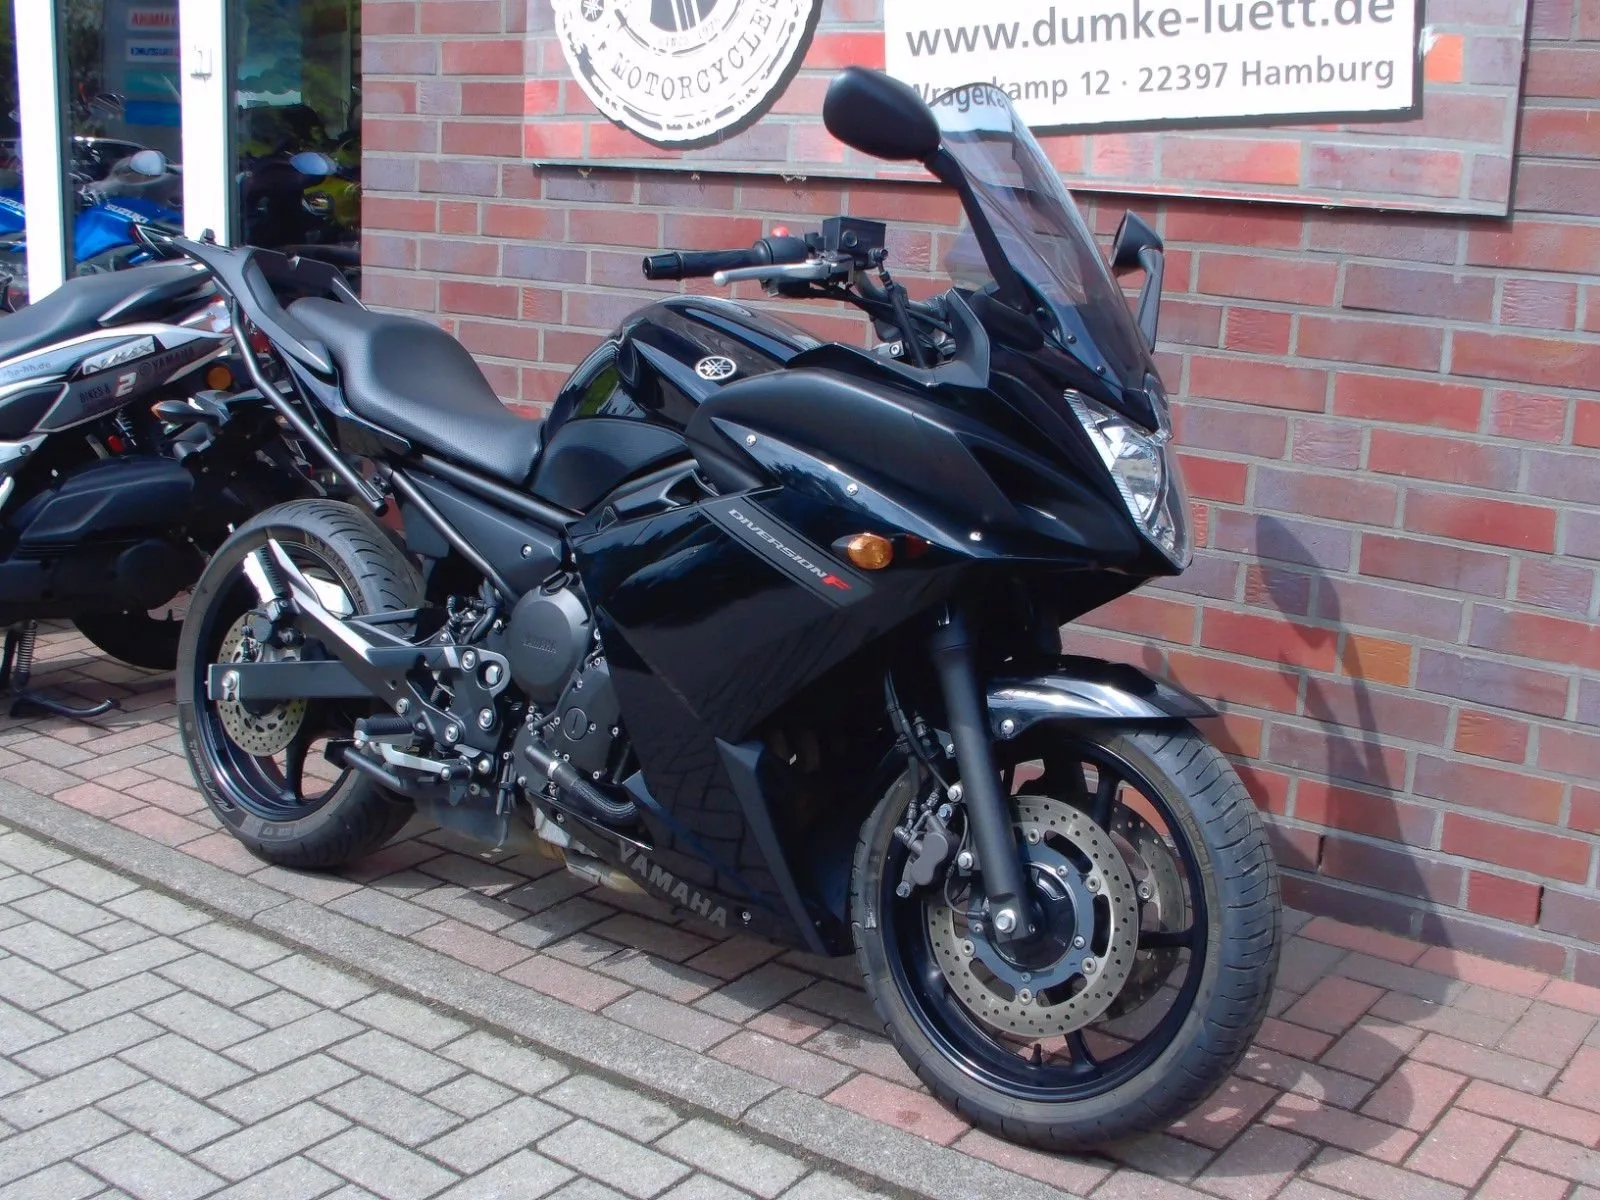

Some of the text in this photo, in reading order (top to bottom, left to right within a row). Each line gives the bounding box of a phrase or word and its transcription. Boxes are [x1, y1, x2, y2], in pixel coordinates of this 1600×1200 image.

[906, 0, 1394, 56] www.dumke-luett.de
[1081, 69, 1110, 96] 12
[1138, 62, 1228, 92] 22397
[1241, 55, 1394, 89] Hamburg
[620, 841, 727, 929] YAMAHA
